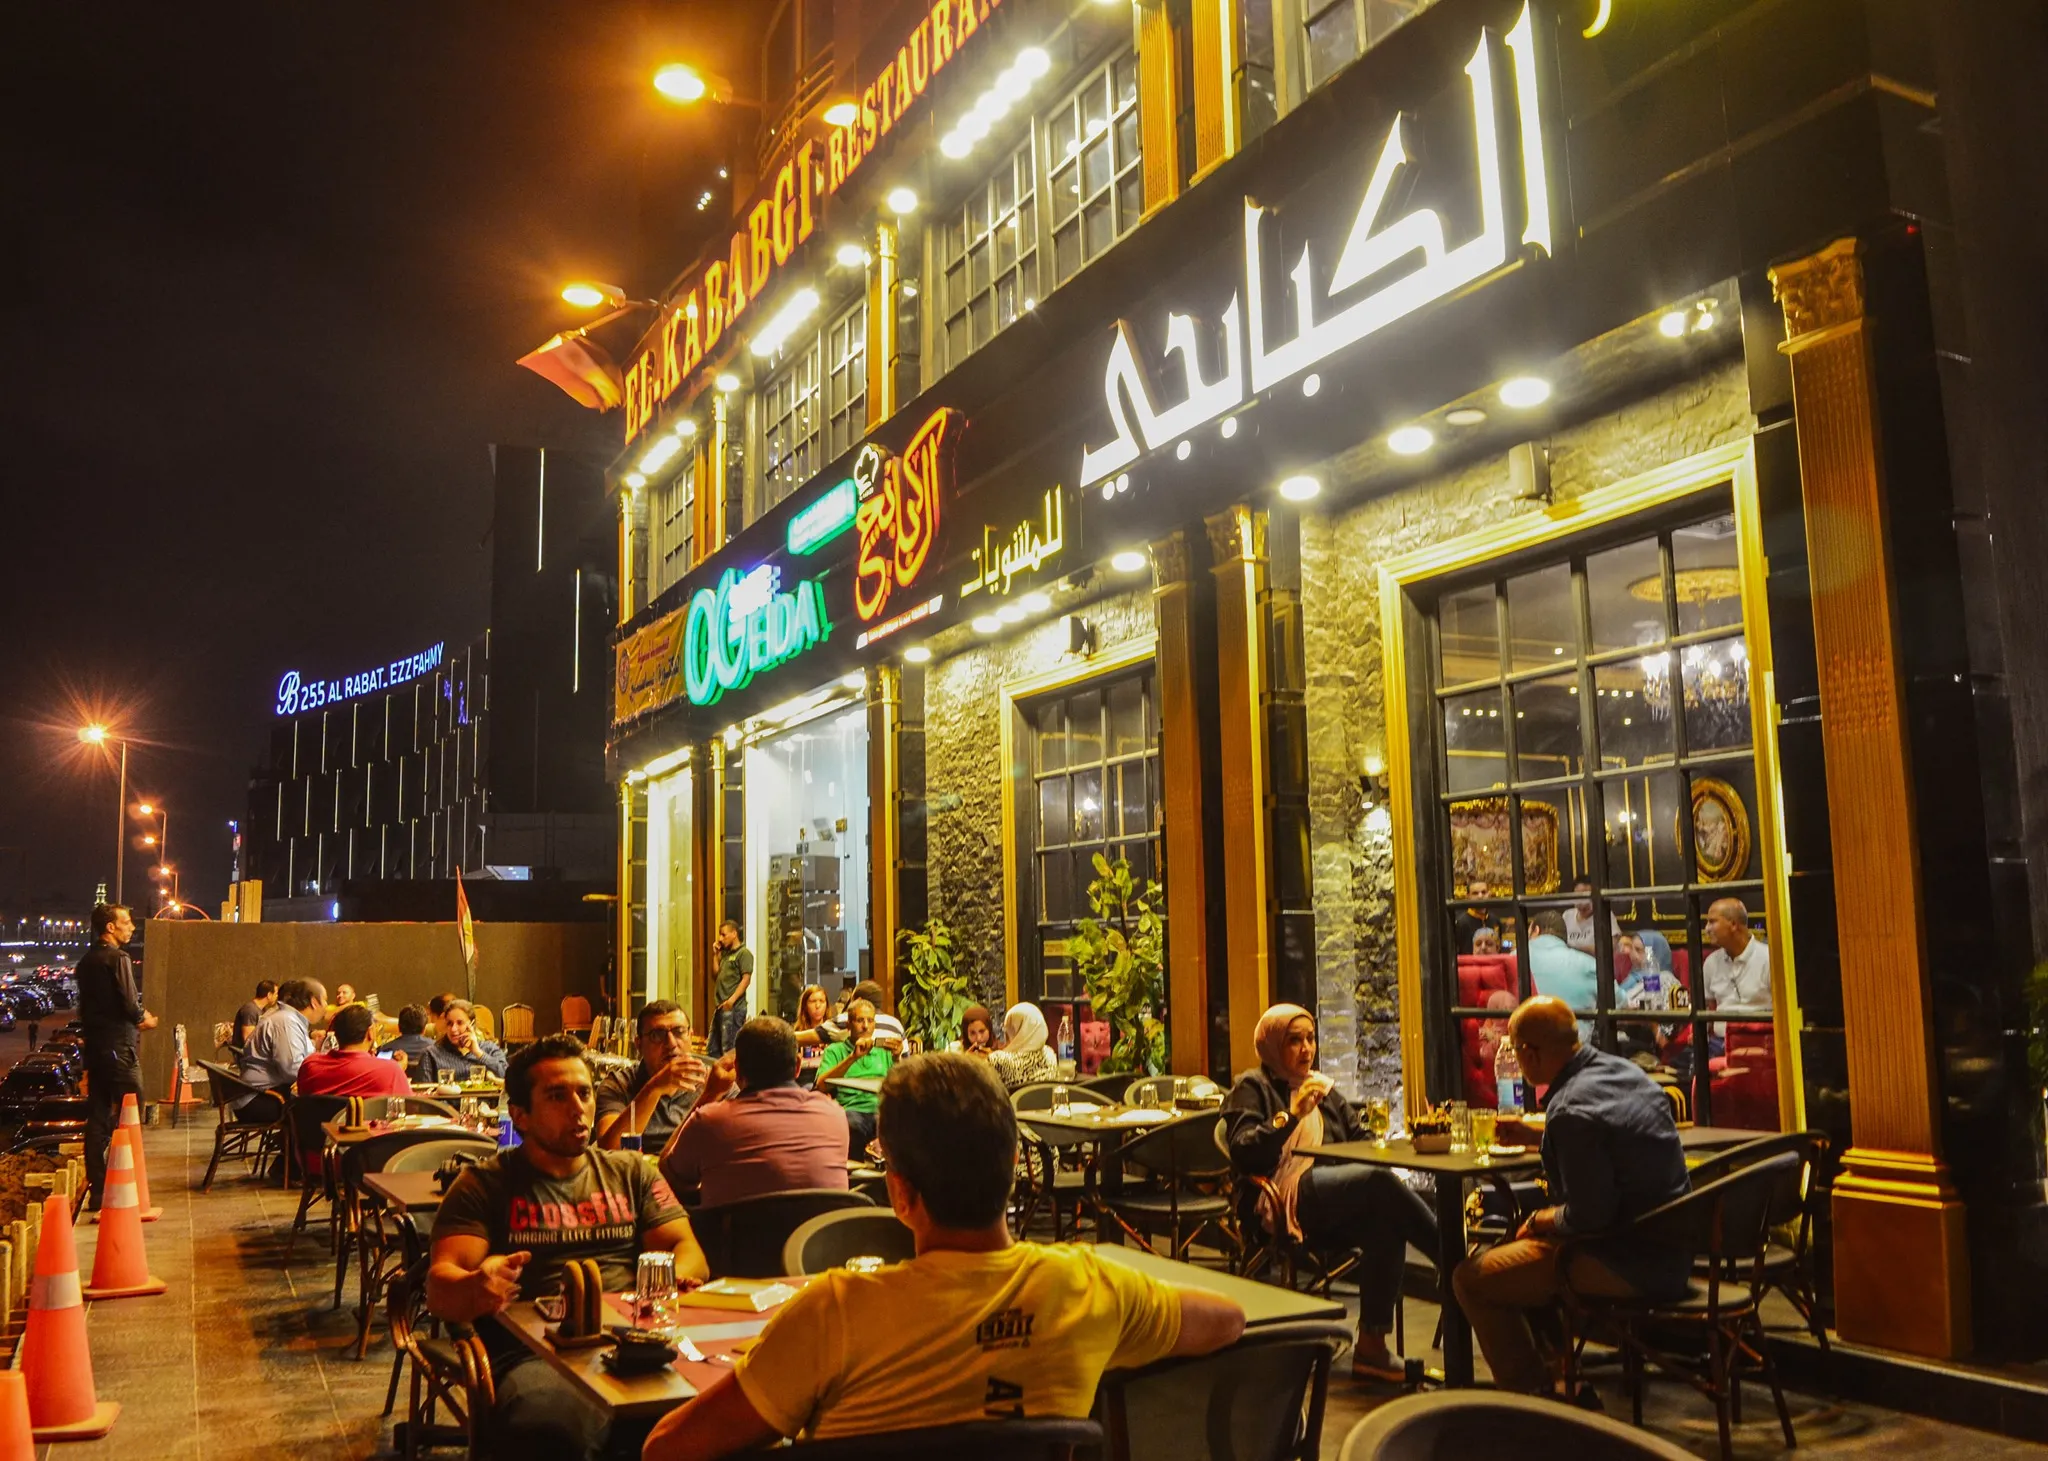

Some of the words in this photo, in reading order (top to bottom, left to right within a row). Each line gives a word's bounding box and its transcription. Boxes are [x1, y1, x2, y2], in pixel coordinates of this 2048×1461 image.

[828, 0, 1003, 196] RESTAURA
[960, 483, 1063, 598] للمشويات
[300, 680, 325, 711] 255
[328, 680, 342, 703] AL
[561, 1228, 592, 1243] ELITE
[595, 1224, 634, 1241] FITNESS
